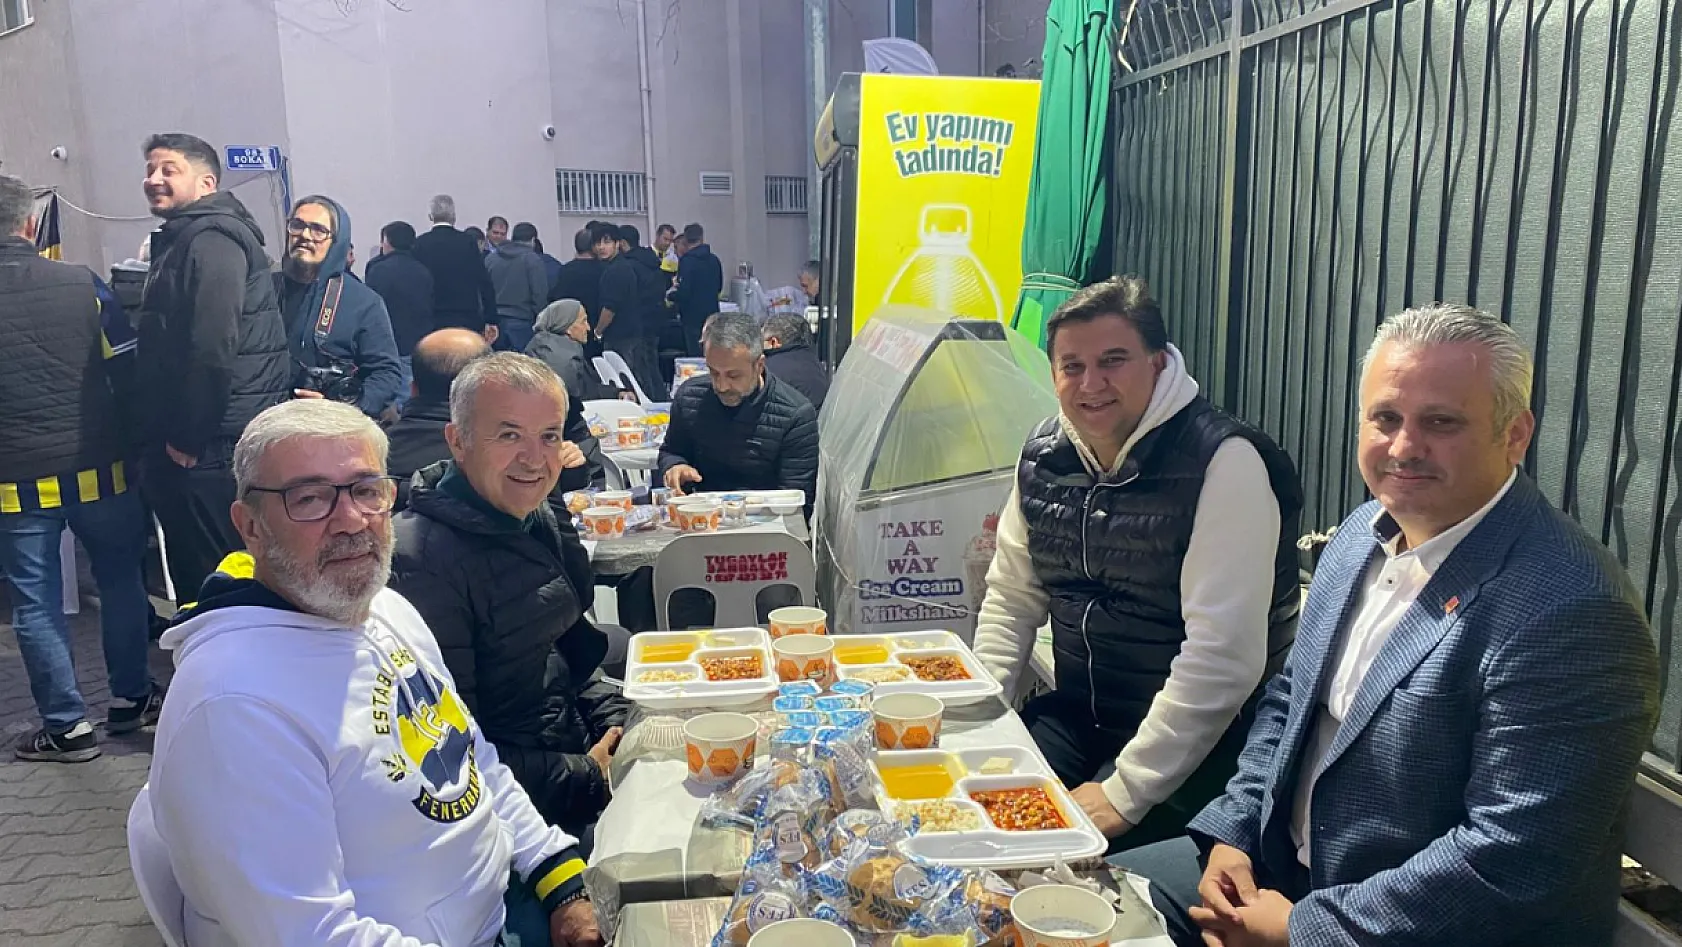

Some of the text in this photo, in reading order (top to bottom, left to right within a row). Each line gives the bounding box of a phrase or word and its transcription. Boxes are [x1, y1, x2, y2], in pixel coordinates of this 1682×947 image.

[885, 112, 1013, 146] Ev yapımı
[895, 143, 1004, 177] tadında!
[879, 519, 944, 538] TAKE
[902, 539, 920, 556] A
[887, 557, 939, 575] WAY
[859, 577, 964, 599] Ice Cream
[861, 603, 968, 624] Milkshake
